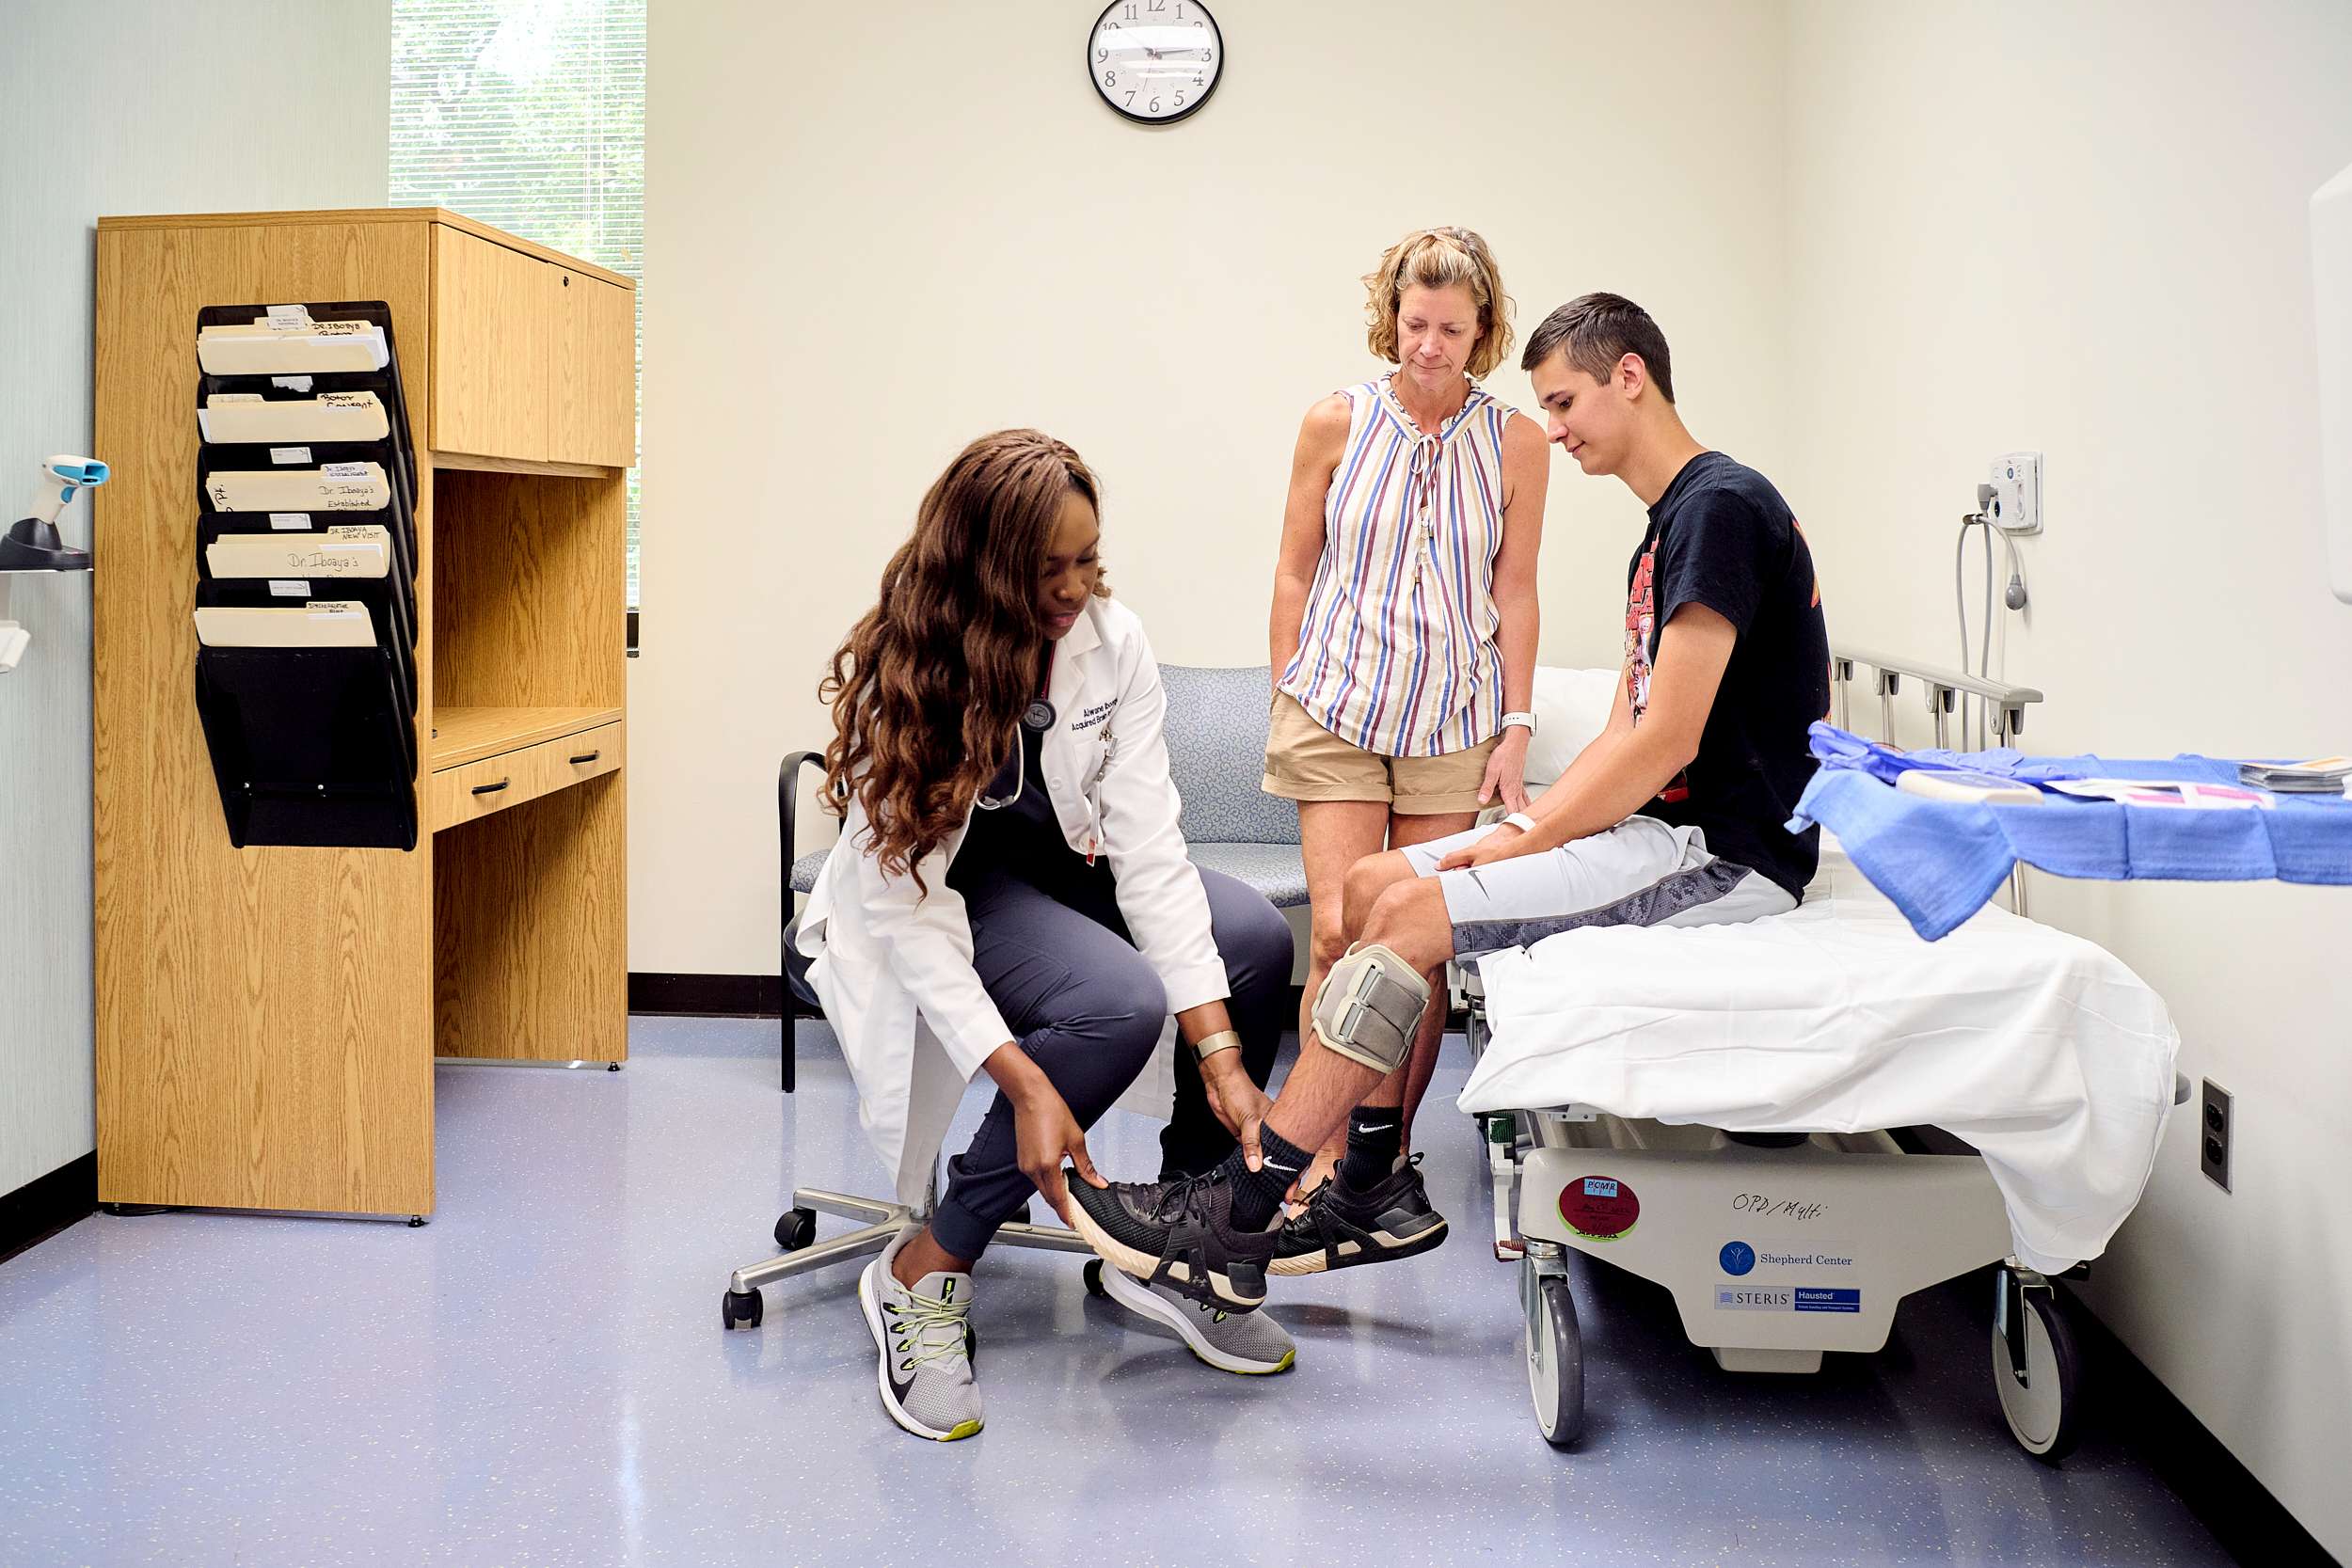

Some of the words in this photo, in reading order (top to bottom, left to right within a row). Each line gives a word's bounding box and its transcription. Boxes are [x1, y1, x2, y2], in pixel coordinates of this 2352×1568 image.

[1124, 4, 1138, 21] 11
[1176, 4, 1184, 20] 1
[1098, 48, 1109, 64] 9
[1201, 47, 1212, 62] 3
[1104, 71, 1116, 87] 8
[1192, 71, 1204, 87] 4
[1125, 90, 1136, 107] 7
[1149, 96, 1160, 113] 6
[1174, 89, 1184, 106] 5
[1760, 1253, 1813, 1266] Shepherd
[1816, 1255, 1852, 1266] Center
[1736, 1292, 1789, 1305] STERIS
[1798, 1291, 1835, 1300] Hausted
